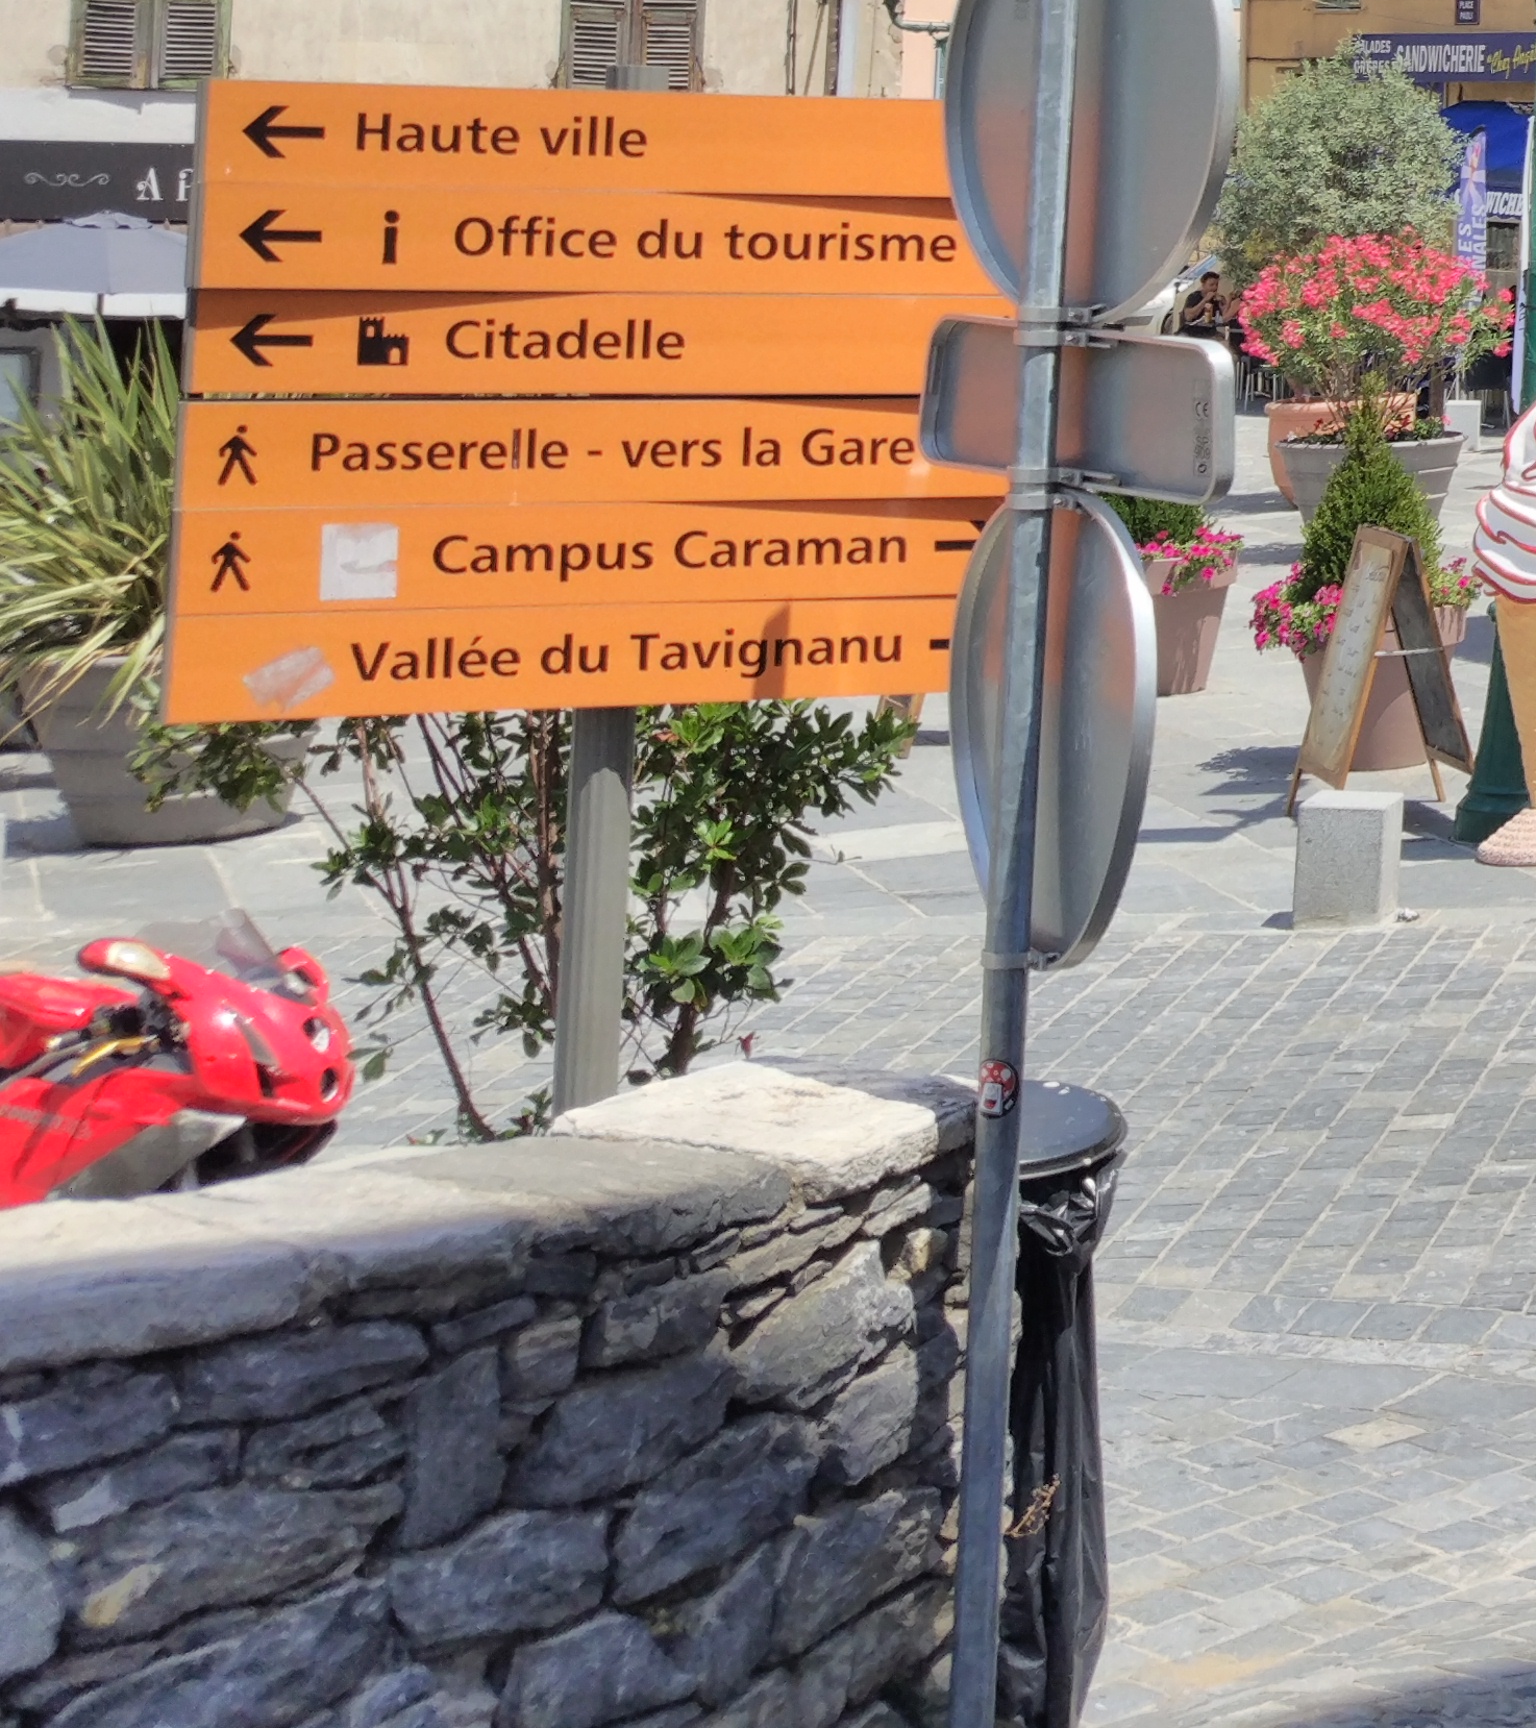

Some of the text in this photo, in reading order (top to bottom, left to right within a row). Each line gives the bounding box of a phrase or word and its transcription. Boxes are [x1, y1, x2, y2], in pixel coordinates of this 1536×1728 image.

[356, 112, 648, 158] Haute ville
[454, 215, 618, 259] Office
[637, 218, 703, 260] du
[724, 222, 957, 263] tourisme
[445, 318, 685, 360] Citadelle
[311, 428, 569, 472] Passerelle
[621, 439, 722, 468] vers
[742, 427, 781, 467] la
[801, 428, 914, 468] Gare
[432, 530, 907, 583] Campus Caraman
[350, 628, 904, 682] Vallée du Tavignanu
